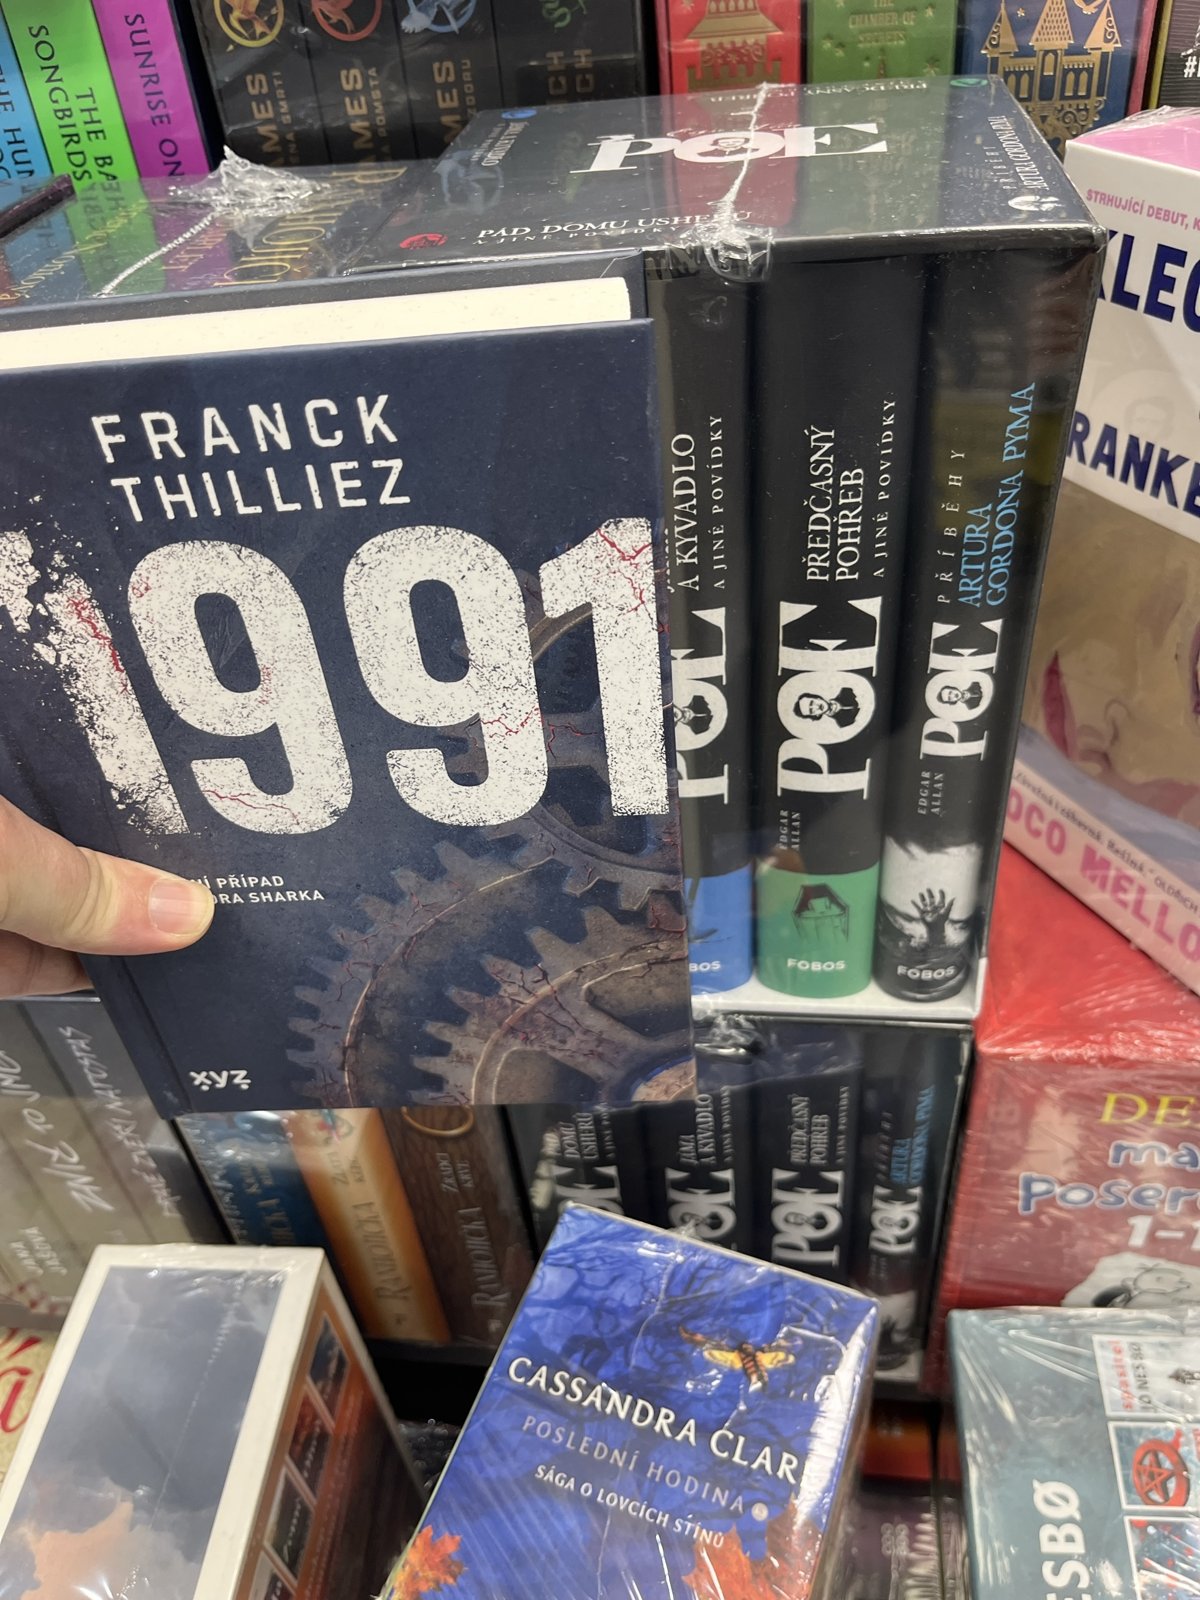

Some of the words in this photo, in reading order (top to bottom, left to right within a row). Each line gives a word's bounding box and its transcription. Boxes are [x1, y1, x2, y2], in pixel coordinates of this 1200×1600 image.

[848, 12, 898, 28] CHAMBER
[902, 11, 916, 25] OF
[28, 25, 92, 182] SONGBIRDS
[76, 87, 107, 142] THE
[124, 14, 171, 126] SUNRISE
[158, 138, 185, 178] ON
[570, 121, 888, 175] POE
[476, 224, 532, 240] PÁD
[539, 218, 630, 235] DOMU
[1086, 188, 1146, 216] STRHUJÍCÍ
[1147, 204, 1189, 231] DEBUT,
[91, 394, 399, 464] FRANCK
[875, 393, 897, 501] POVÍDKY
[1001, 381, 1037, 463] PYMA
[110, 458, 412, 522] THILLIEZ
[705, 415, 726, 515] POVÍDKY
[669, 433, 700, 572] KYVADLO
[803, 425, 837, 582] PŘEDČASNÝ
[832, 467, 865, 582] POHŘEB
[871, 510, 890, 559] JINÉ
[934, 448, 966, 605] PŘÍBĚHY
[706, 523, 729, 571] JINÉ
[958, 502, 993, 607] ARTURA
[985, 469, 1024, 607] GORDONA
[678, 574, 700, 593] A
[712, 579, 727, 590] A
[873, 566, 886, 578] A
[0, 517, 670, 836] 1991
[777, 595, 883, 800] POE
[920, 617, 1004, 761] POE
[917, 770, 933, 817] EDGAR
[930, 771, 946, 818] ALLAN
[217, 873, 285, 889] PŘÍPAD
[249, 889, 326, 904] SHARKA
[786, 957, 847, 973] FOBOS
[896, 963, 956, 981] FOBOS
[695, 1093, 717, 1154] KYVADLO
[808, 1114, 831, 1165] POHŘEB
[770, 1167, 845, 1268] POE
[868, 1184, 924, 1255] POE
[1018, 1171, 1200, 1227] Poser
[508, 1357, 698, 1448] CASSANDRA
[522, 1415, 640, 1471] POSLEDNÍ
[646, 1460, 744, 1514] HODINA
[535, 1464, 576, 1492] SÁGA
[580, 1482, 593, 1497] O
[596, 1487, 670, 1529] LOVCÍCH
[672, 1513, 726, 1549] STÍNŮ
